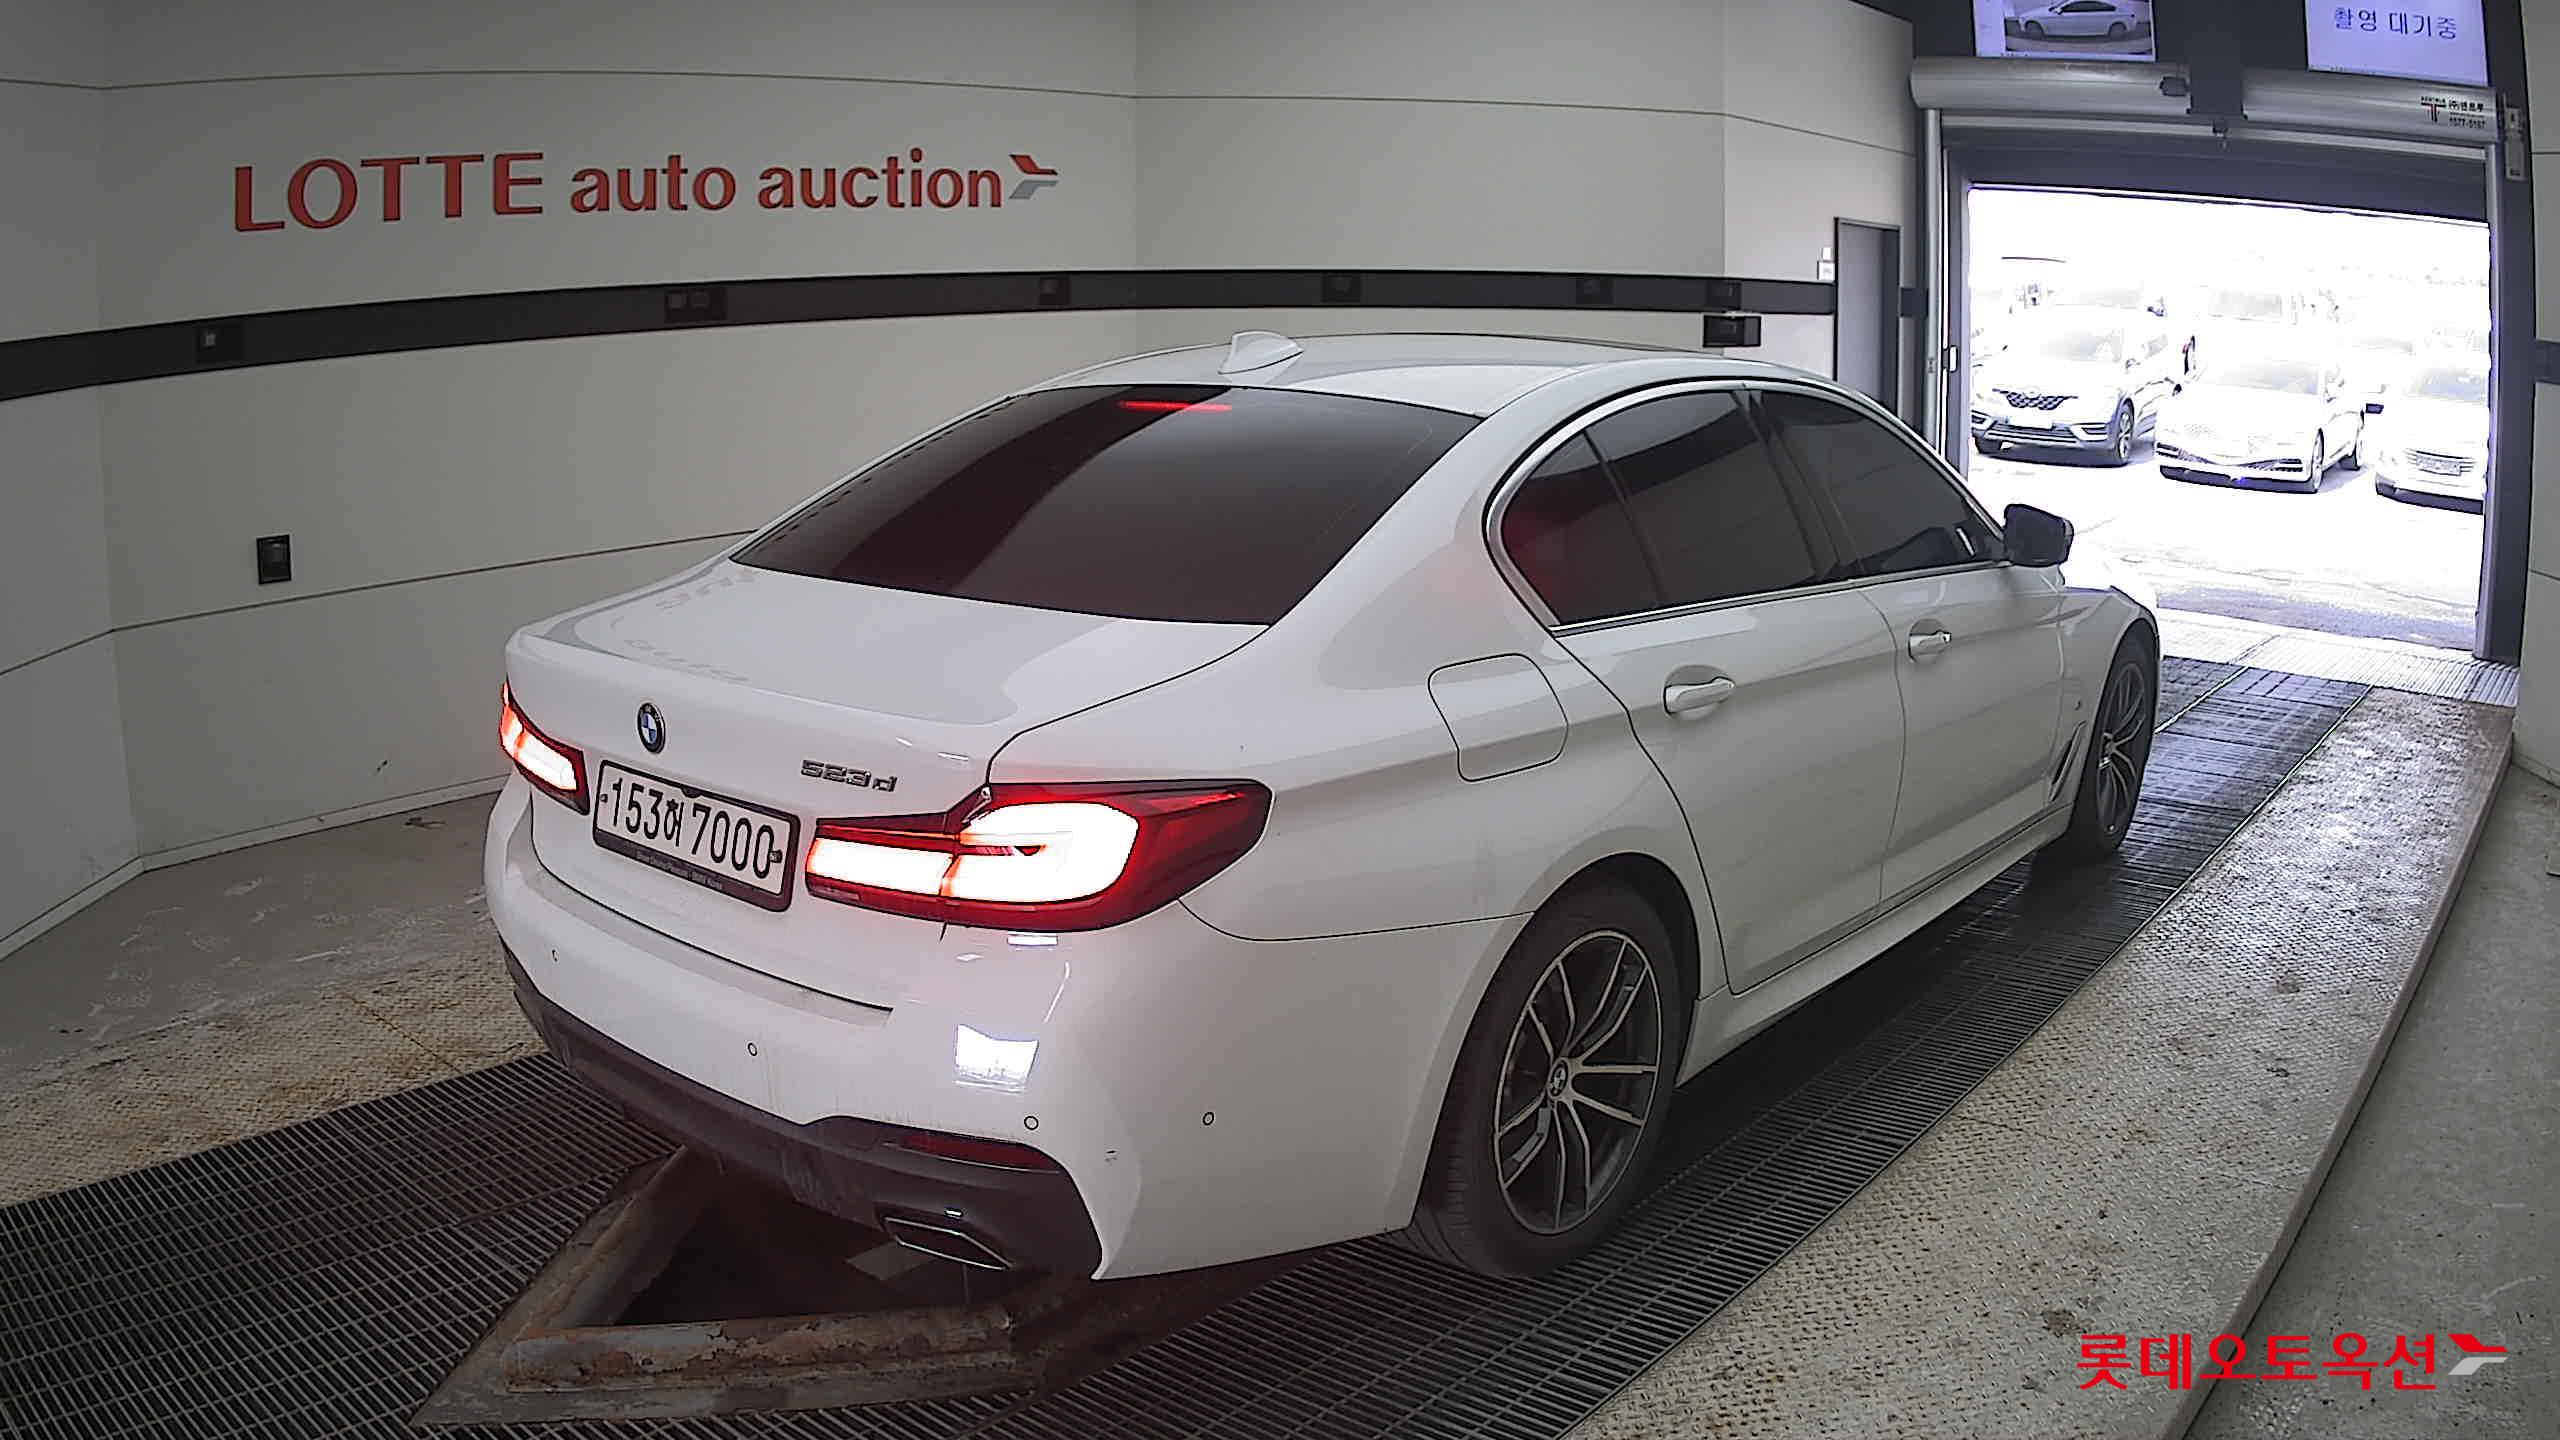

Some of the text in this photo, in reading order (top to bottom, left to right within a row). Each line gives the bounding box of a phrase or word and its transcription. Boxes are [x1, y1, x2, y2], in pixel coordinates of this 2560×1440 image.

[2335, 7, 2457, 40] 촬영 대기중
[234, 147, 1002, 233] LOTTE auto auction
[801, 759, 898, 793] 523d
[691, 803, 775, 880] 7000
